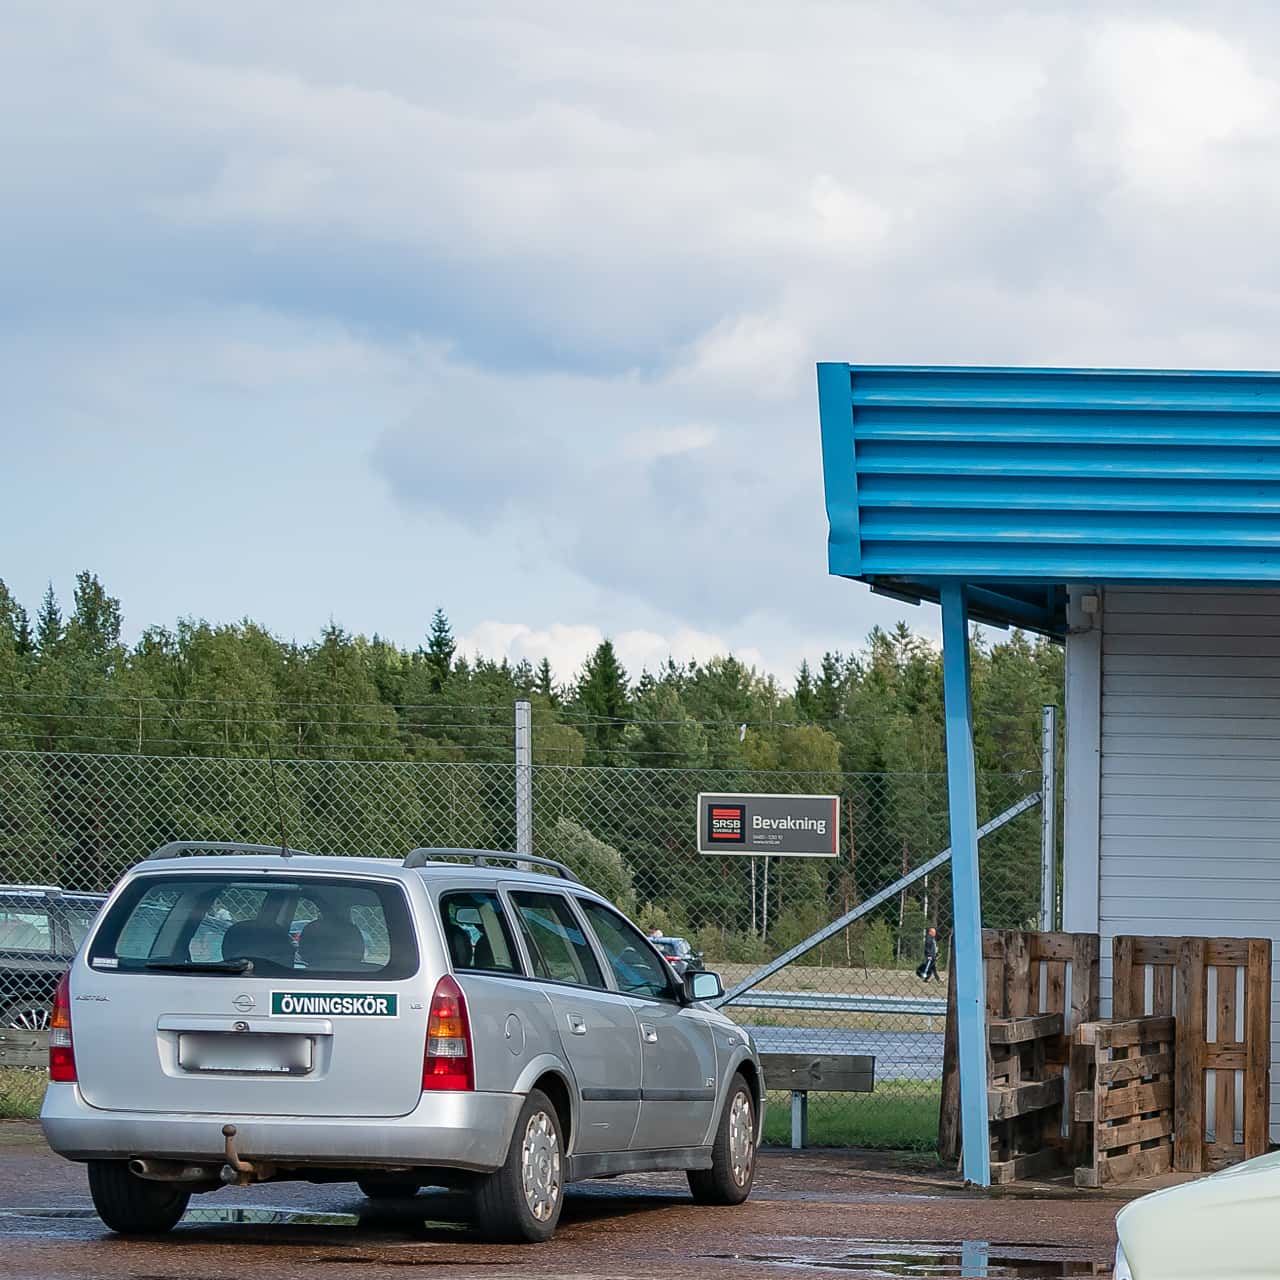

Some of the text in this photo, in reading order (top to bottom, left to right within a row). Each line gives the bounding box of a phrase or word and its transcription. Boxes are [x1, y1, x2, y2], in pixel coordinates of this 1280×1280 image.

[713, 819, 741, 828] SRSB
[752, 815, 826, 834] Bevakning
[281, 994, 388, 1014] ÖVNINGSKÖR
